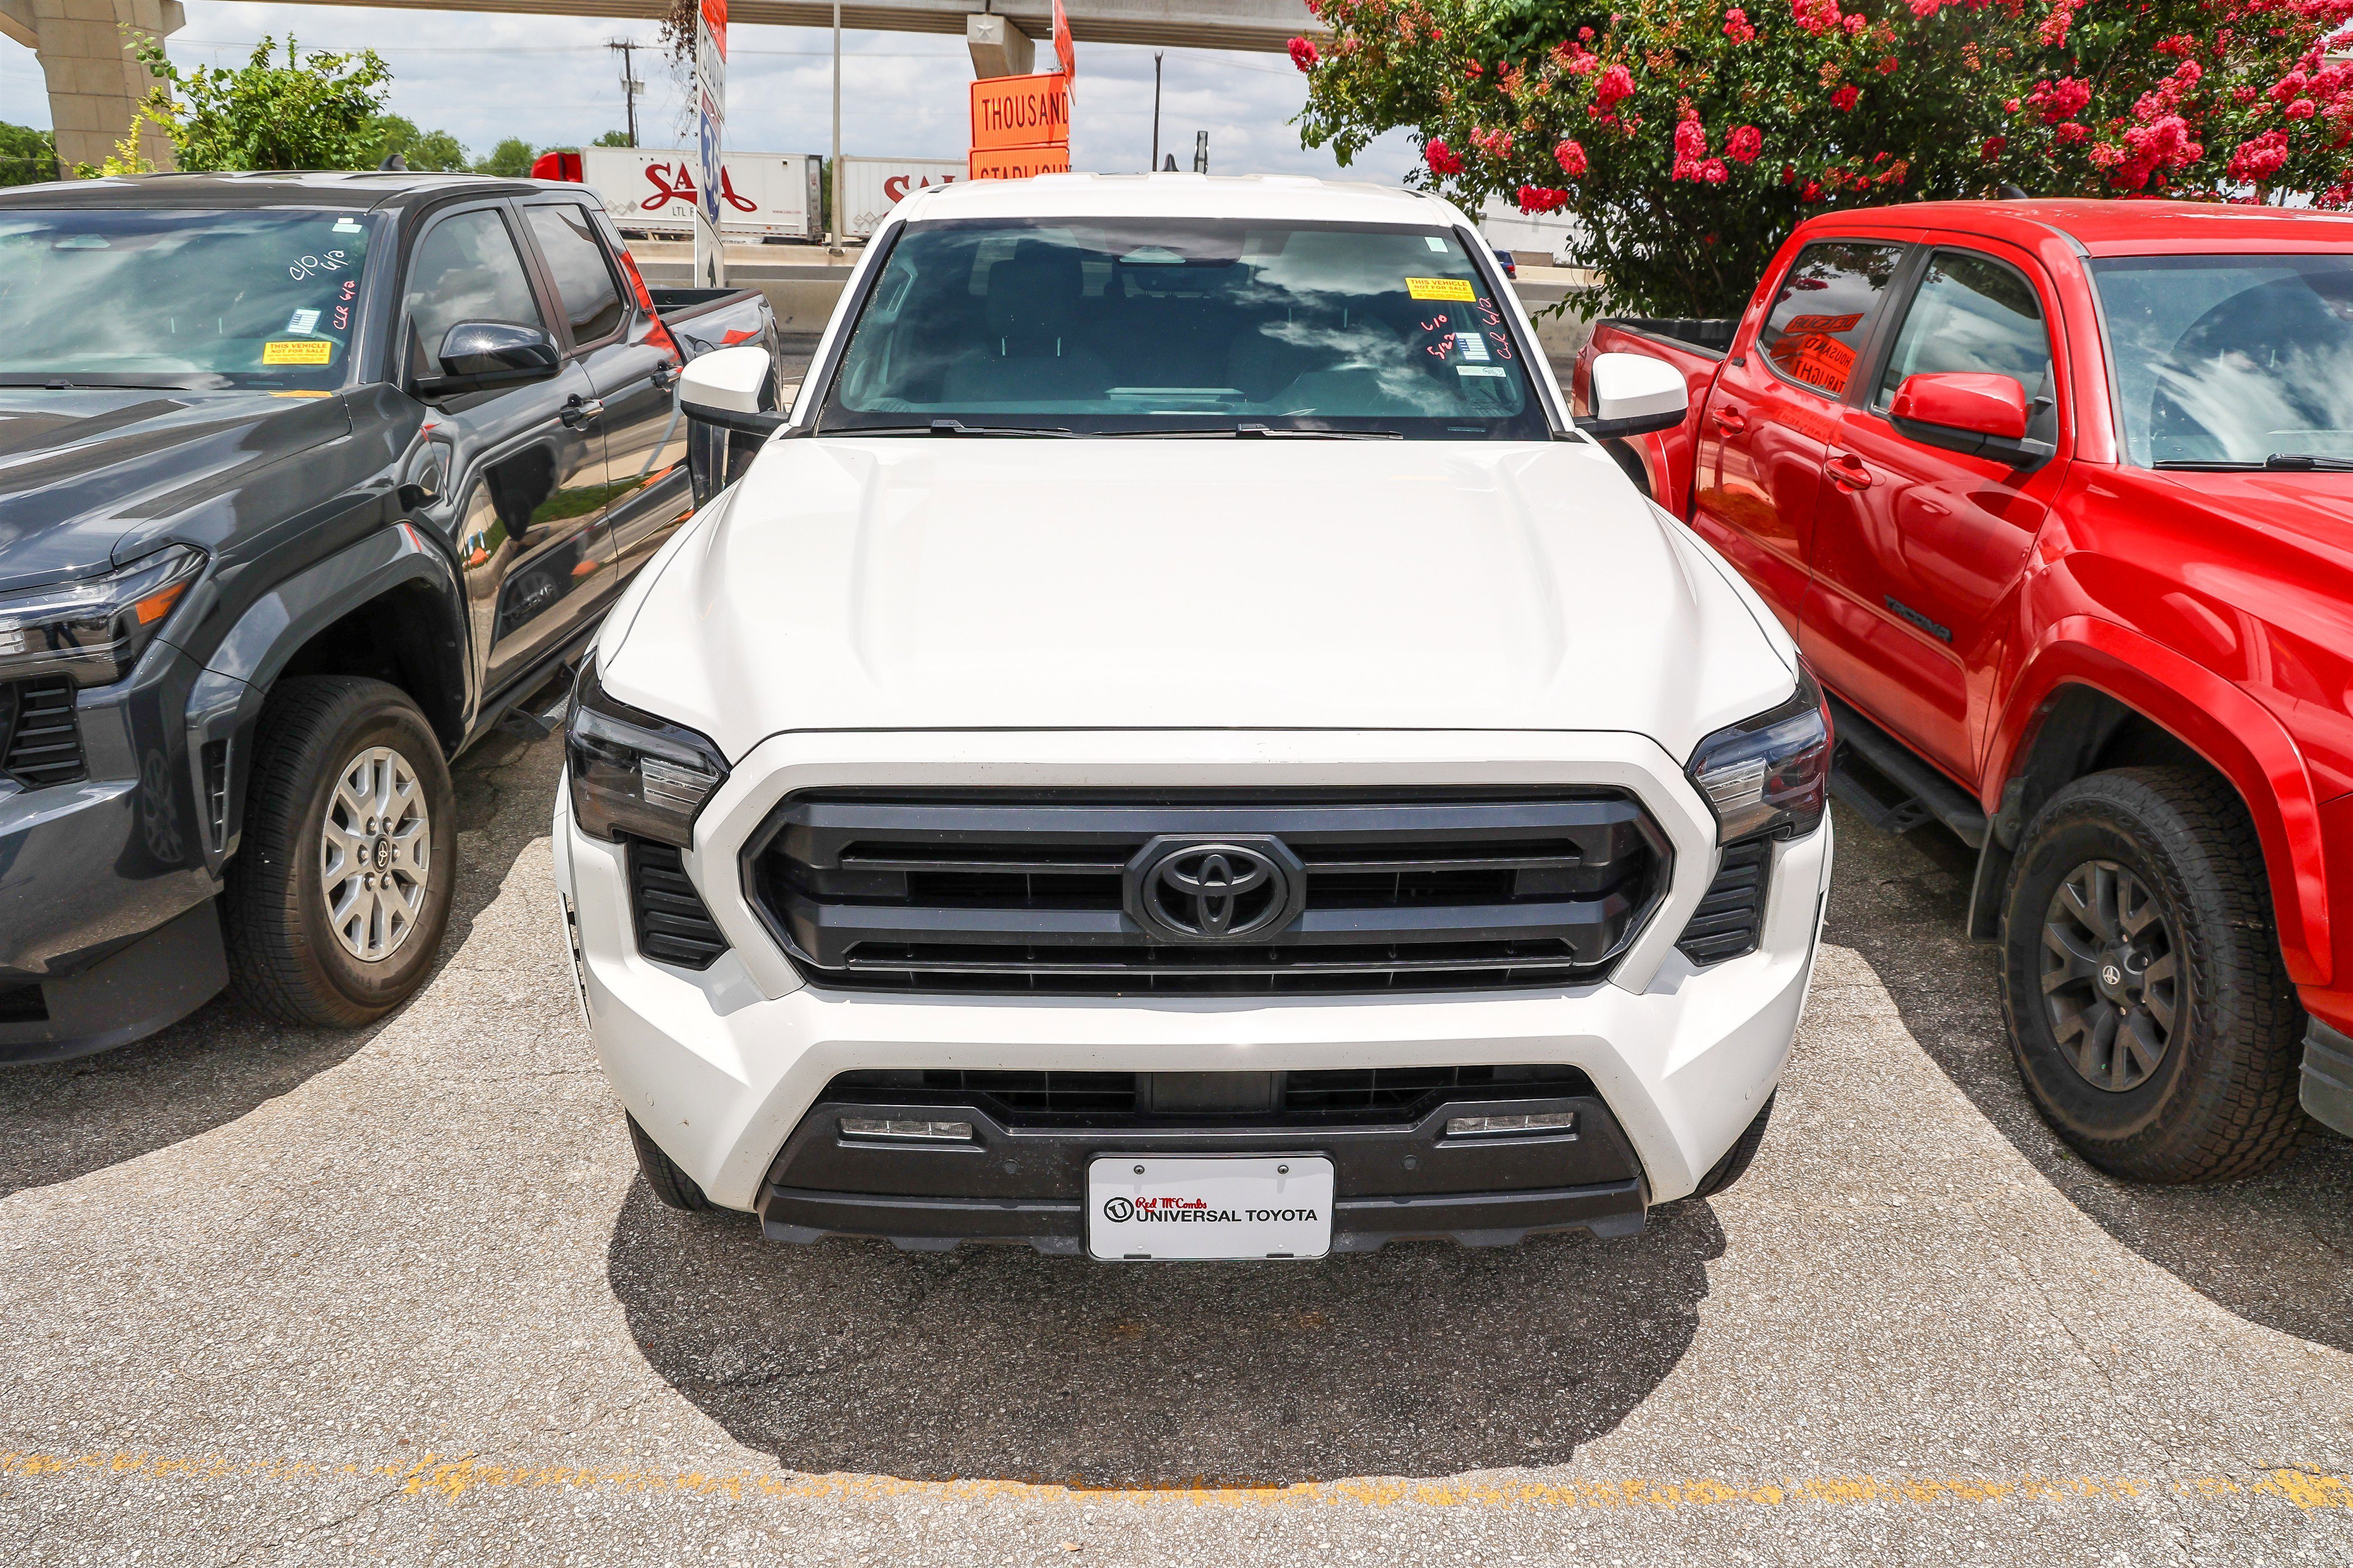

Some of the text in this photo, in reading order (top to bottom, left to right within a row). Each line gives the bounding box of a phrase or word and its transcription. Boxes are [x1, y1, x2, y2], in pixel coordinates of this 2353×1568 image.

[704, 34, 723, 104] SOUTH
[982, 92, 1068, 131] THOUSAND
[704, 123, 719, 206] 35
[641, 162, 758, 212] SAA
[672, 206, 686, 217] LTL
[1884, 594, 1953, 642] TACOMA
[1135, 1196, 1207, 1213] Red McCombs
[1136, 1209, 1318, 1222] UNIVERSAL TOYOTA
